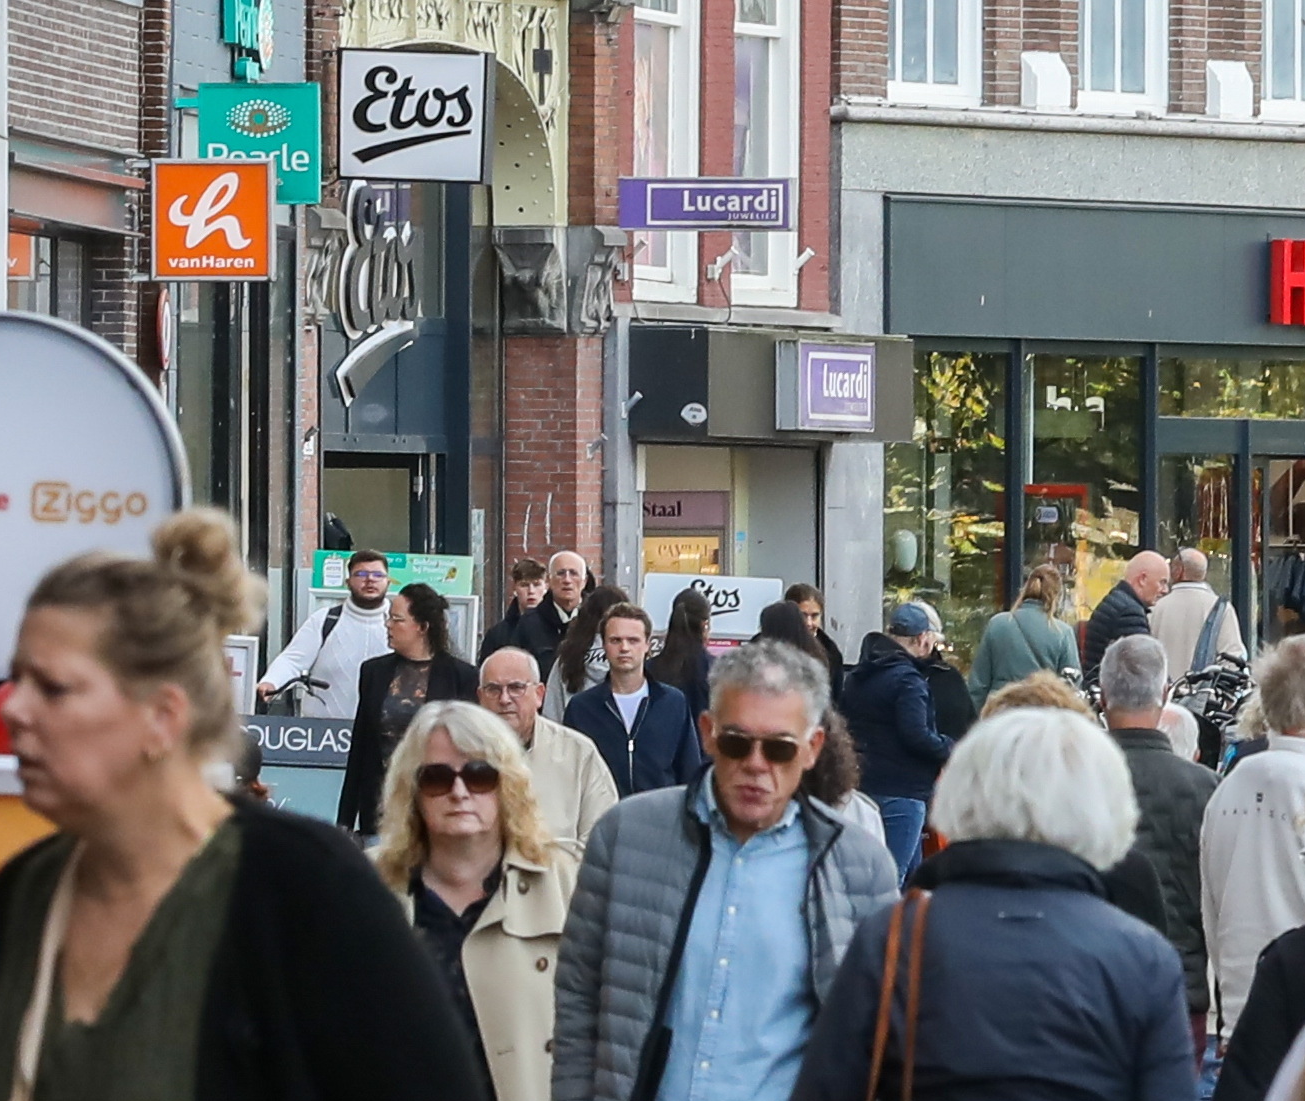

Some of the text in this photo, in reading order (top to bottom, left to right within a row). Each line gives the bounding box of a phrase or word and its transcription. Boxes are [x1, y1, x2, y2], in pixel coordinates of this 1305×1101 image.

[352, 65, 473, 134] Etos
[682, 189, 777, 212] Lucardi
[728, 212, 777, 221] JUWELIER
[168, 255, 255, 269] vanHaren
[822, 362, 868, 400] Lucardi
[30, 480, 148, 523] Ziggo
[643, 500, 682, 517] Staal
[240, 725, 352, 753] UGLAS
